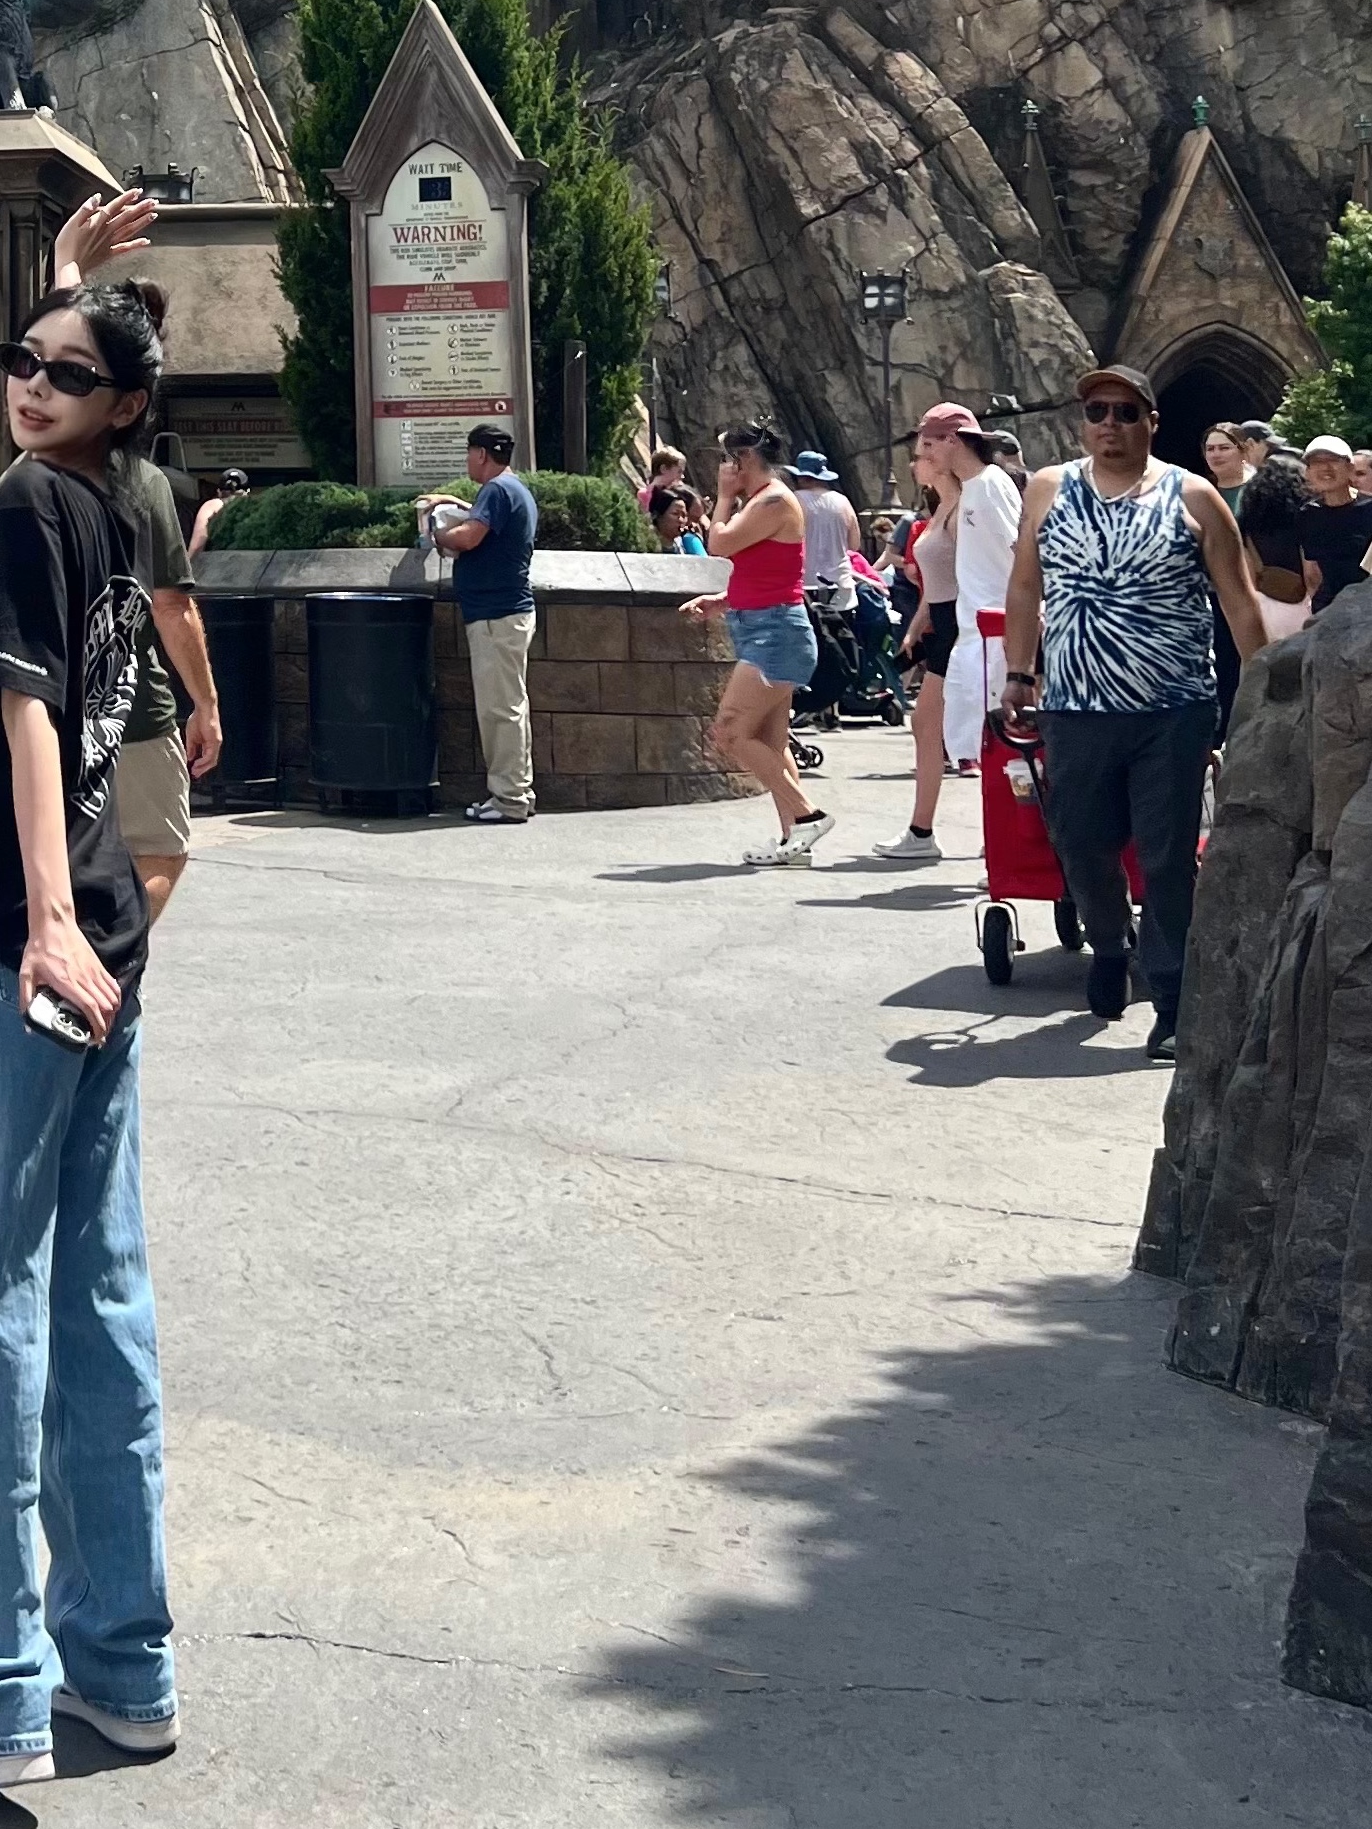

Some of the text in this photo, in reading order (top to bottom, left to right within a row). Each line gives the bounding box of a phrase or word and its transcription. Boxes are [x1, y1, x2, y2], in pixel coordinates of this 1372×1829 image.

[408, 162, 463, 175] WAIT TIME
[411, 202, 463, 210] MINUTES
[392, 224, 483, 243] WARNING!
